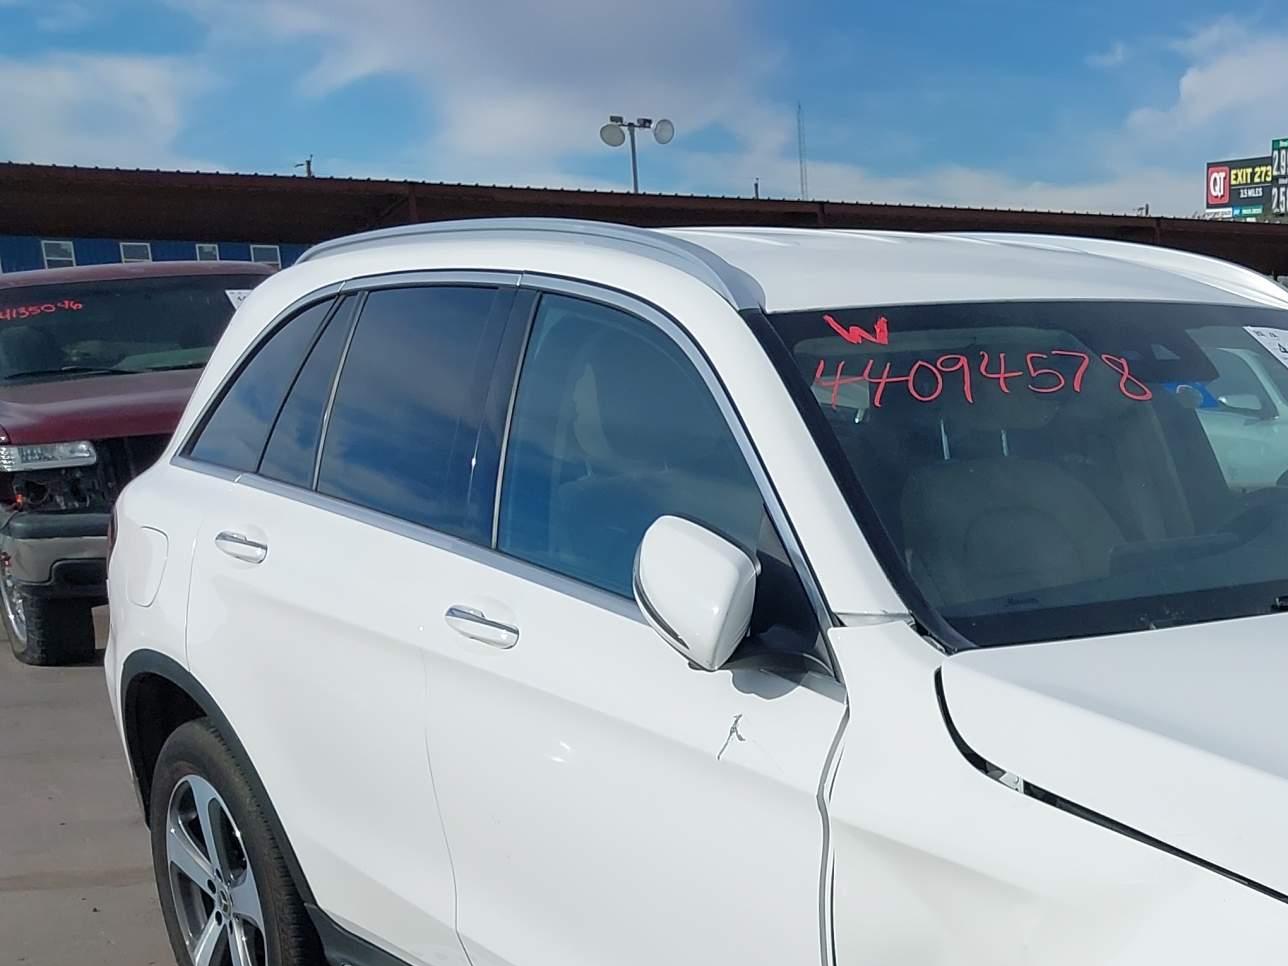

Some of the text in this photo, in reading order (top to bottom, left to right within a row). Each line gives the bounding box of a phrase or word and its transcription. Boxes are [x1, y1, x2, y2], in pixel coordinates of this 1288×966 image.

[1210, 171, 1226, 198] QT
[1231, 165, 1272, 185] EXIT 273
[1248, 188, 1263, 197] MILES
[823, 314, 889, 345] W
[814, 350, 1153, 411] 44094578
